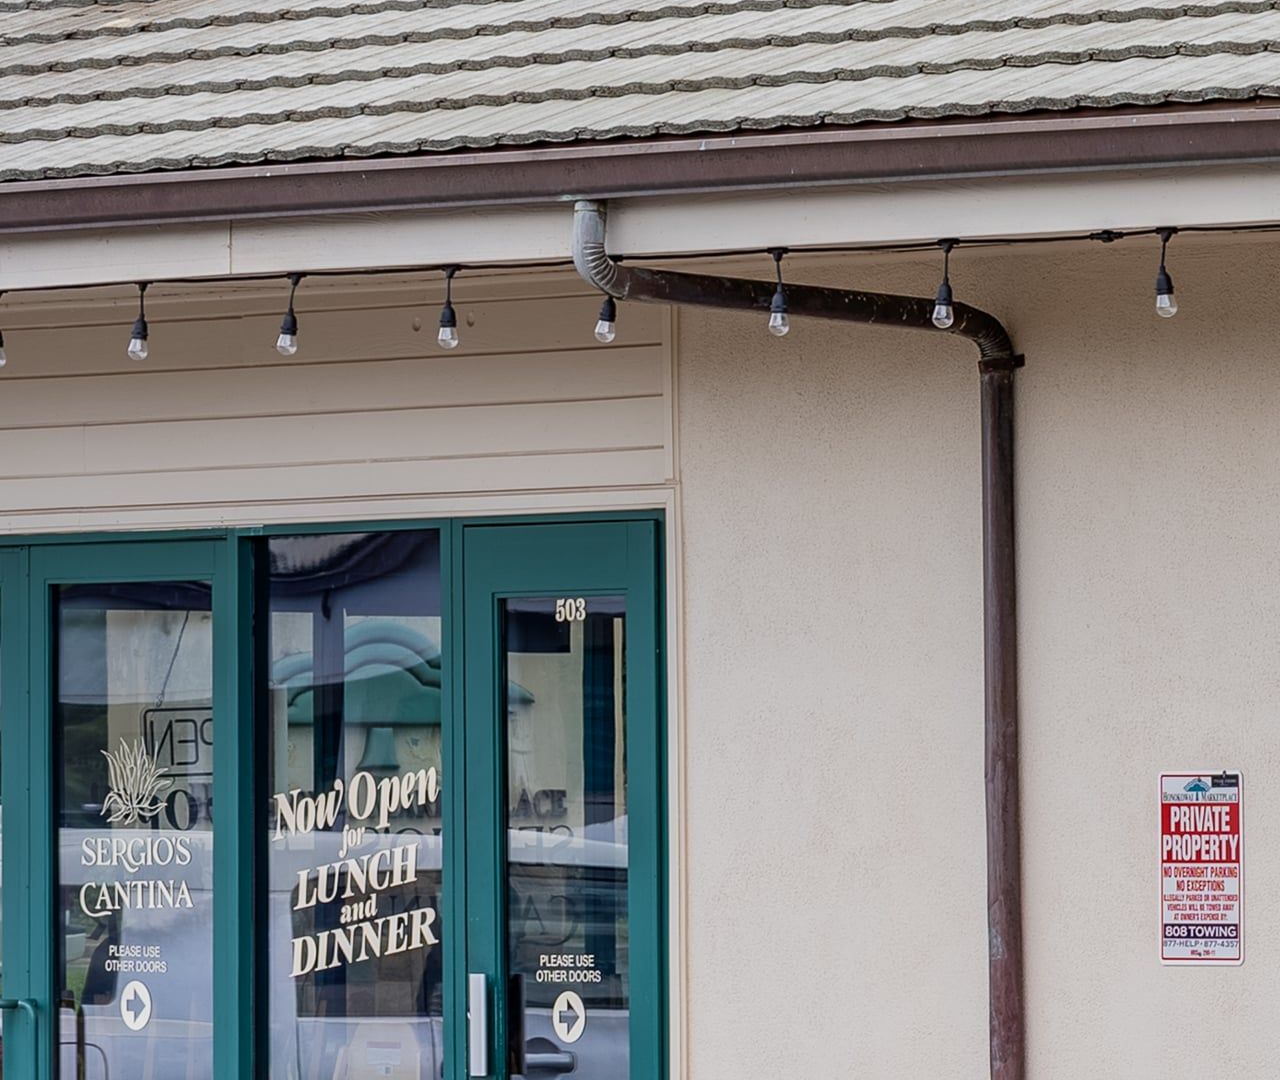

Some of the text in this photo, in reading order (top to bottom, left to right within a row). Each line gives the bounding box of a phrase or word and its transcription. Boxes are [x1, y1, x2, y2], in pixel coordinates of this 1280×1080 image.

[555, 597, 586, 623] 503
[271, 778, 344, 842] Now
[348, 766, 440, 830] Open
[1170, 805, 1231, 832] PRIVATE
[338, 823, 365, 858] for
[1162, 833, 1239, 861] PROPERTY
[80, 836, 192, 873] SERGIO'S
[293, 842, 419, 911] LUNCH
[1164, 866, 1238, 878] NO OVERNIGHT PARKING
[1176, 880, 1225, 891] NO EXCEPTIONS
[79, 879, 194, 918] CANTINA
[339, 893, 378, 924] and
[288, 906, 440, 978] DINNER
[1165, 925, 1237, 937] 808 TOWING
[109, 945, 160, 958] PLEASE USE
[539, 954, 595, 968] PLEASE USE
[104, 959, 168, 973] OTHER DOORS
[536, 969, 601, 983] OTHER DOORS
